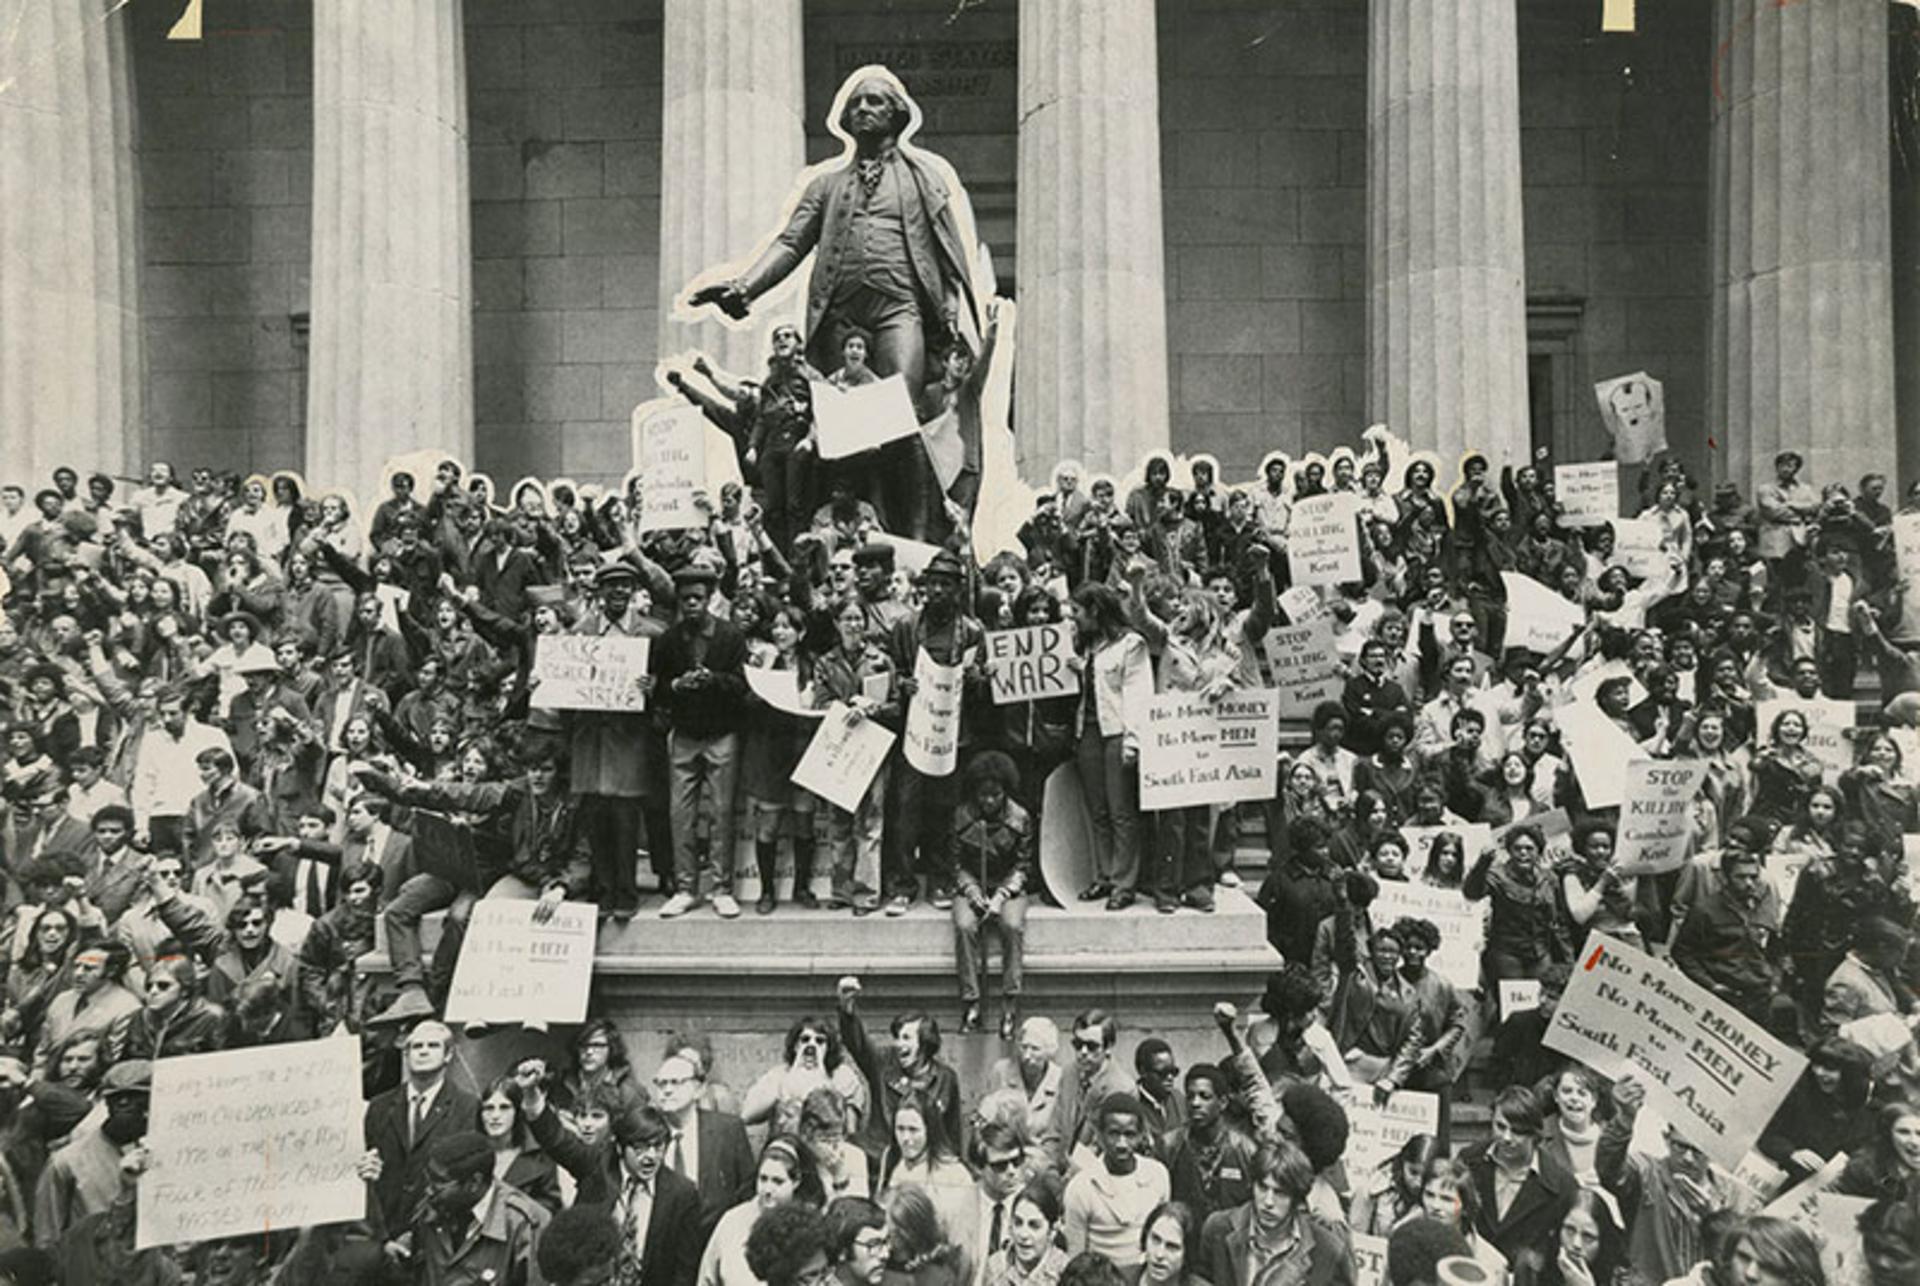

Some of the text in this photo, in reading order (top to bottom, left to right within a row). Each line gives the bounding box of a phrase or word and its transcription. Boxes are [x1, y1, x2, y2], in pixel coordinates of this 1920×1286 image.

[1300, 501, 1334, 514] STOP
[993, 627, 1060, 657] END
[1276, 630, 1312, 646] STOP
[1273, 650, 1328, 667] KILLING
[992, 654, 1064, 695] WAR
[1294, 688, 1325, 702] Kent
[1149, 702, 1267, 721] No More MONEY
[1157, 727, 1256, 747] No More MEN
[1196, 751, 1210, 760] to
[1144, 764, 1262, 788] South East Asia
[1646, 769, 1694, 785] STOP
[1639, 846, 1671, 861] Kent
[1510, 991, 1535, 1003] No
[1597, 950, 1782, 1072] No More MONEY
[1595, 982, 1744, 1087] No More MEN
[1648, 1034, 1667, 1051] to
[1556, 1012, 1726, 1135] South East Asia
